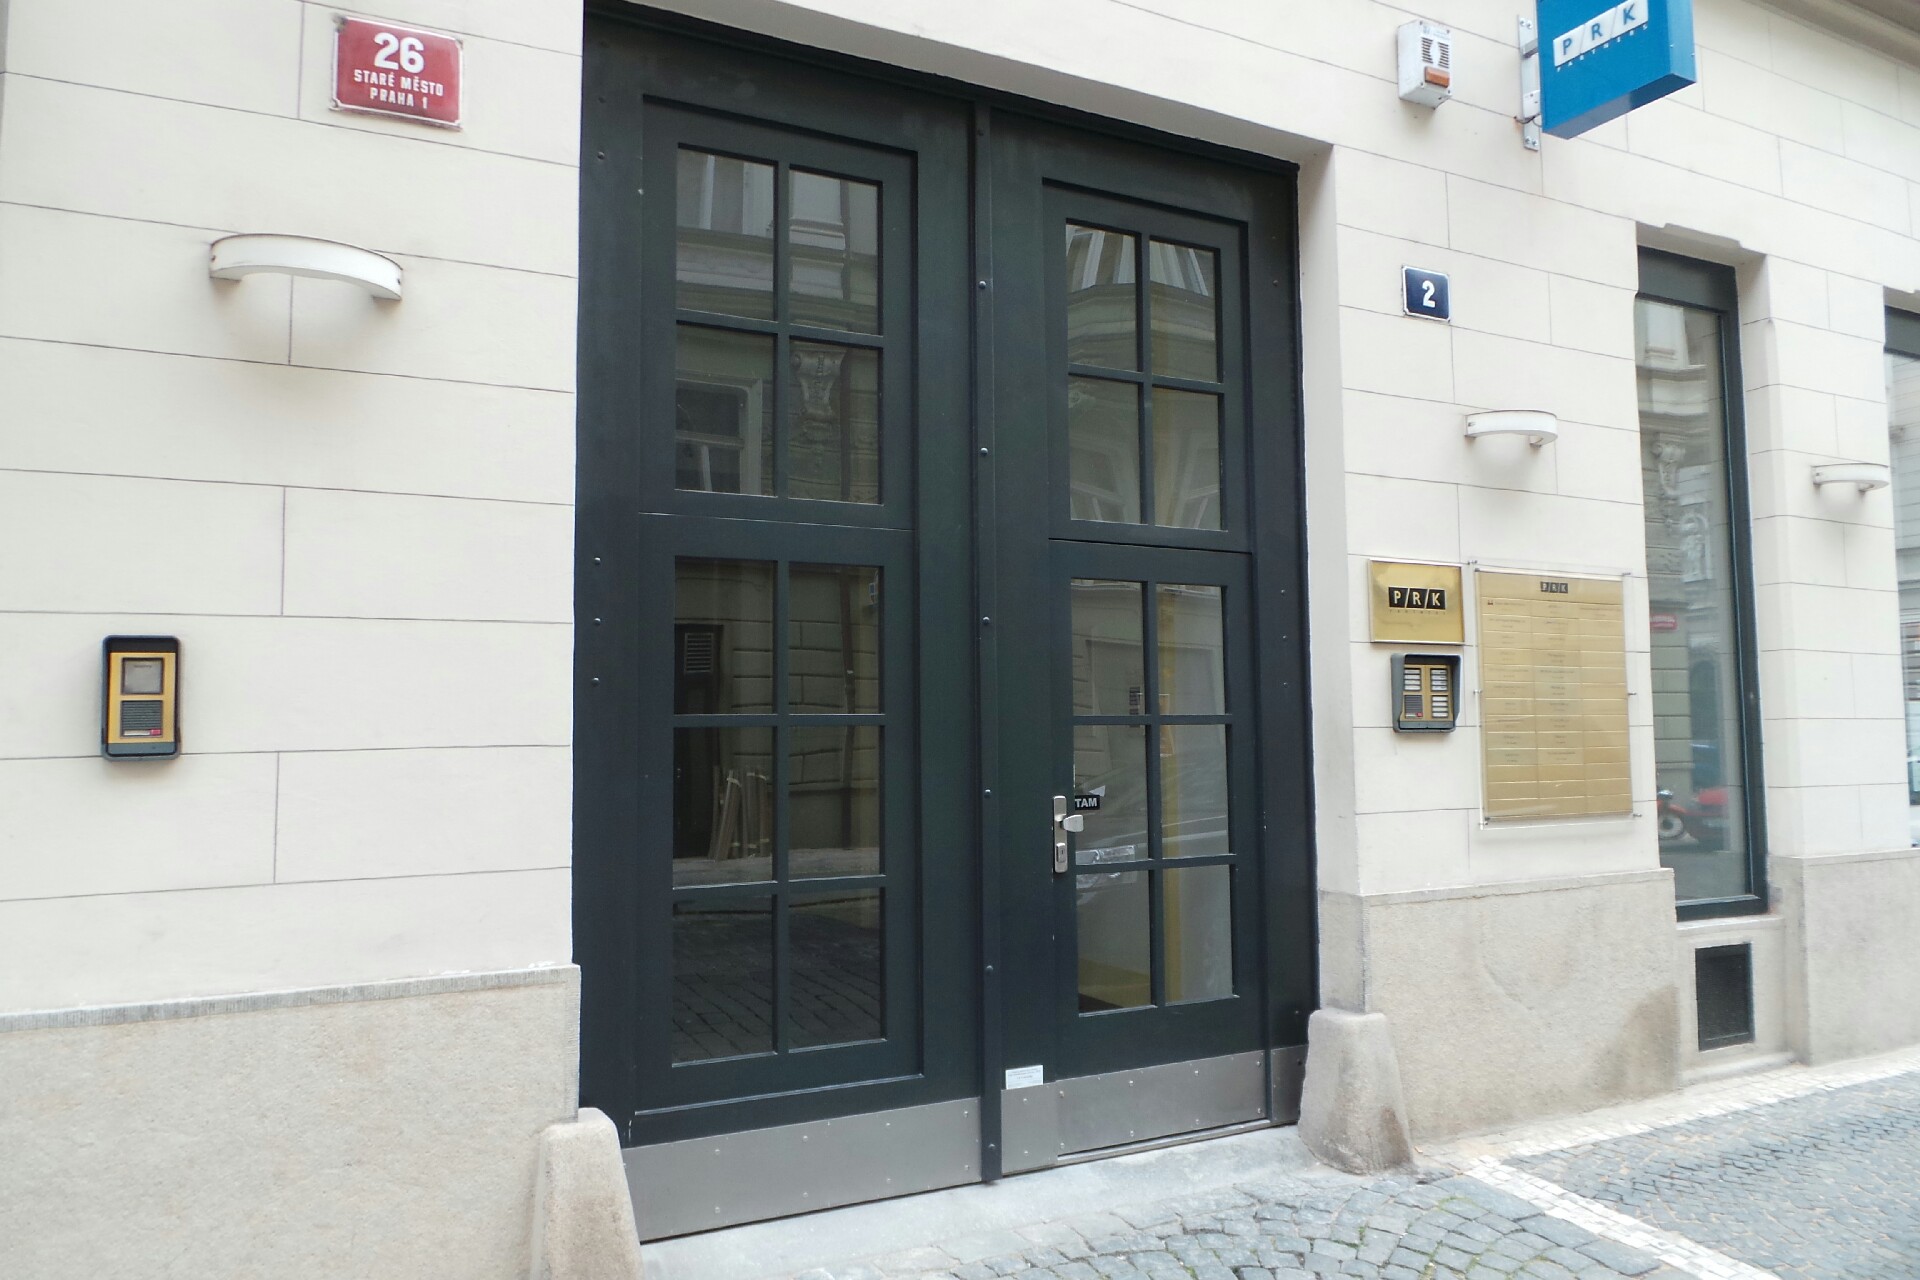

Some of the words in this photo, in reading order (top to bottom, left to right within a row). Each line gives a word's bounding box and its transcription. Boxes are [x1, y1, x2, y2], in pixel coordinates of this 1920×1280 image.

[374, 32, 425, 74] 26
[353, 69, 395, 87] STARÉ
[400, 75, 444, 97] MĚSTO
[370, 87, 414, 107] PRAHA
[422, 97, 428, 109] 1
[1422, 280, 1436, 308] 2
[1074, 797, 1097, 808] TAM
